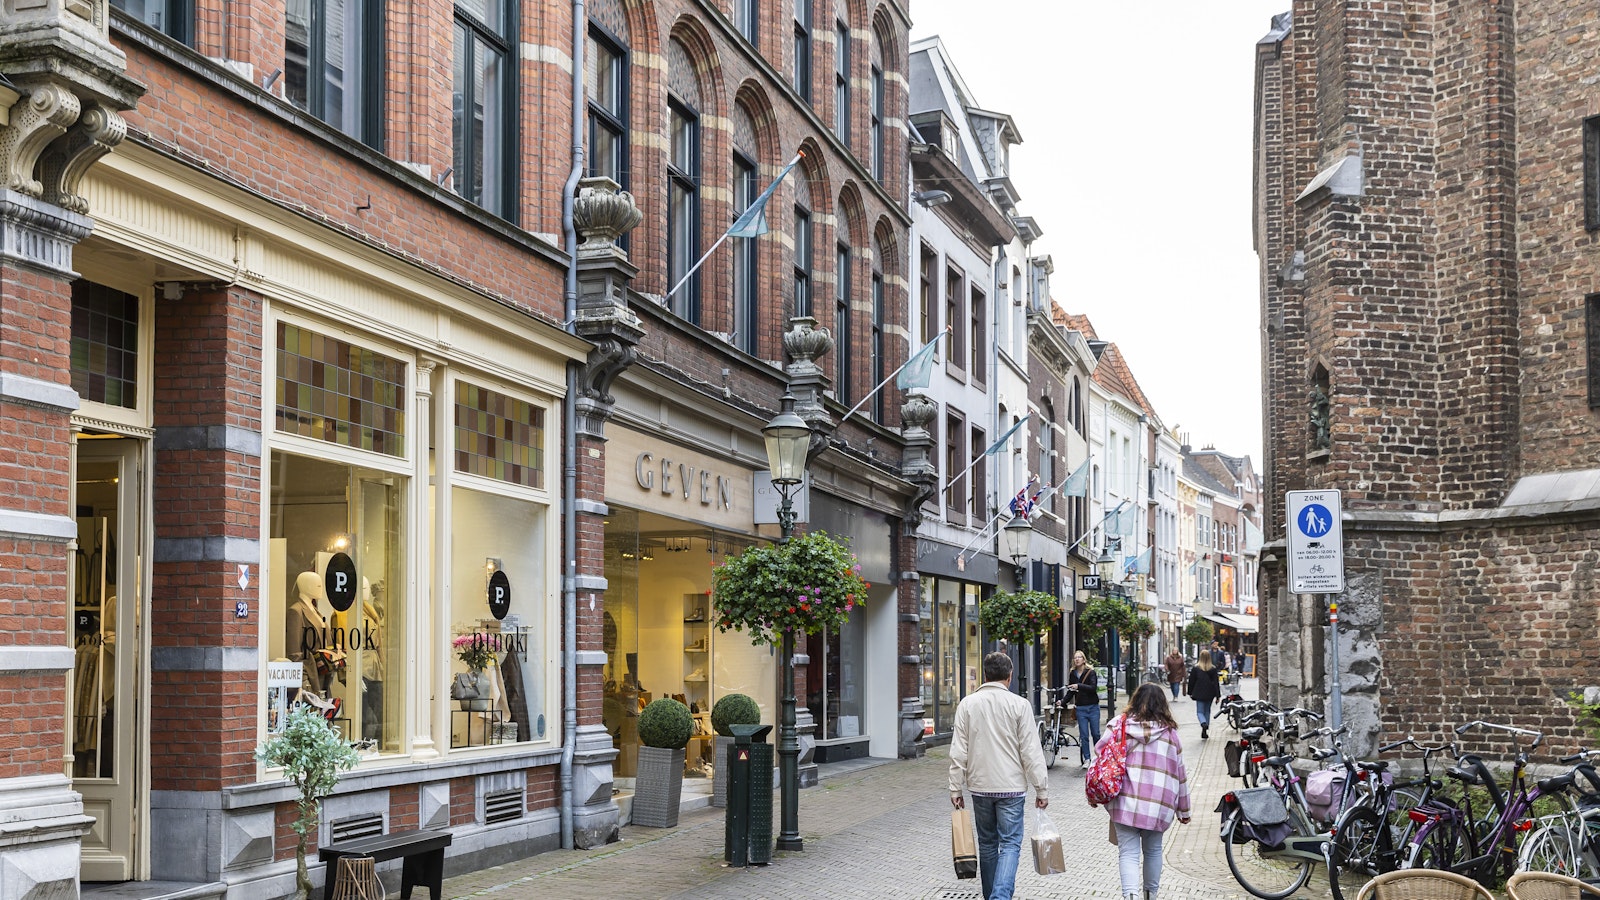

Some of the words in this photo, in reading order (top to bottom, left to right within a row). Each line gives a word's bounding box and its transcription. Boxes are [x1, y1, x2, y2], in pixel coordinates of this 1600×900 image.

[635, 451, 731, 510] GEVEN
[1304, 494, 1325, 502] ZONE
[237, 602, 248, 618] 28
[302, 616, 378, 660] pinok
[473, 623, 525, 660] pinok
[268, 669, 301, 681] VACATURE
